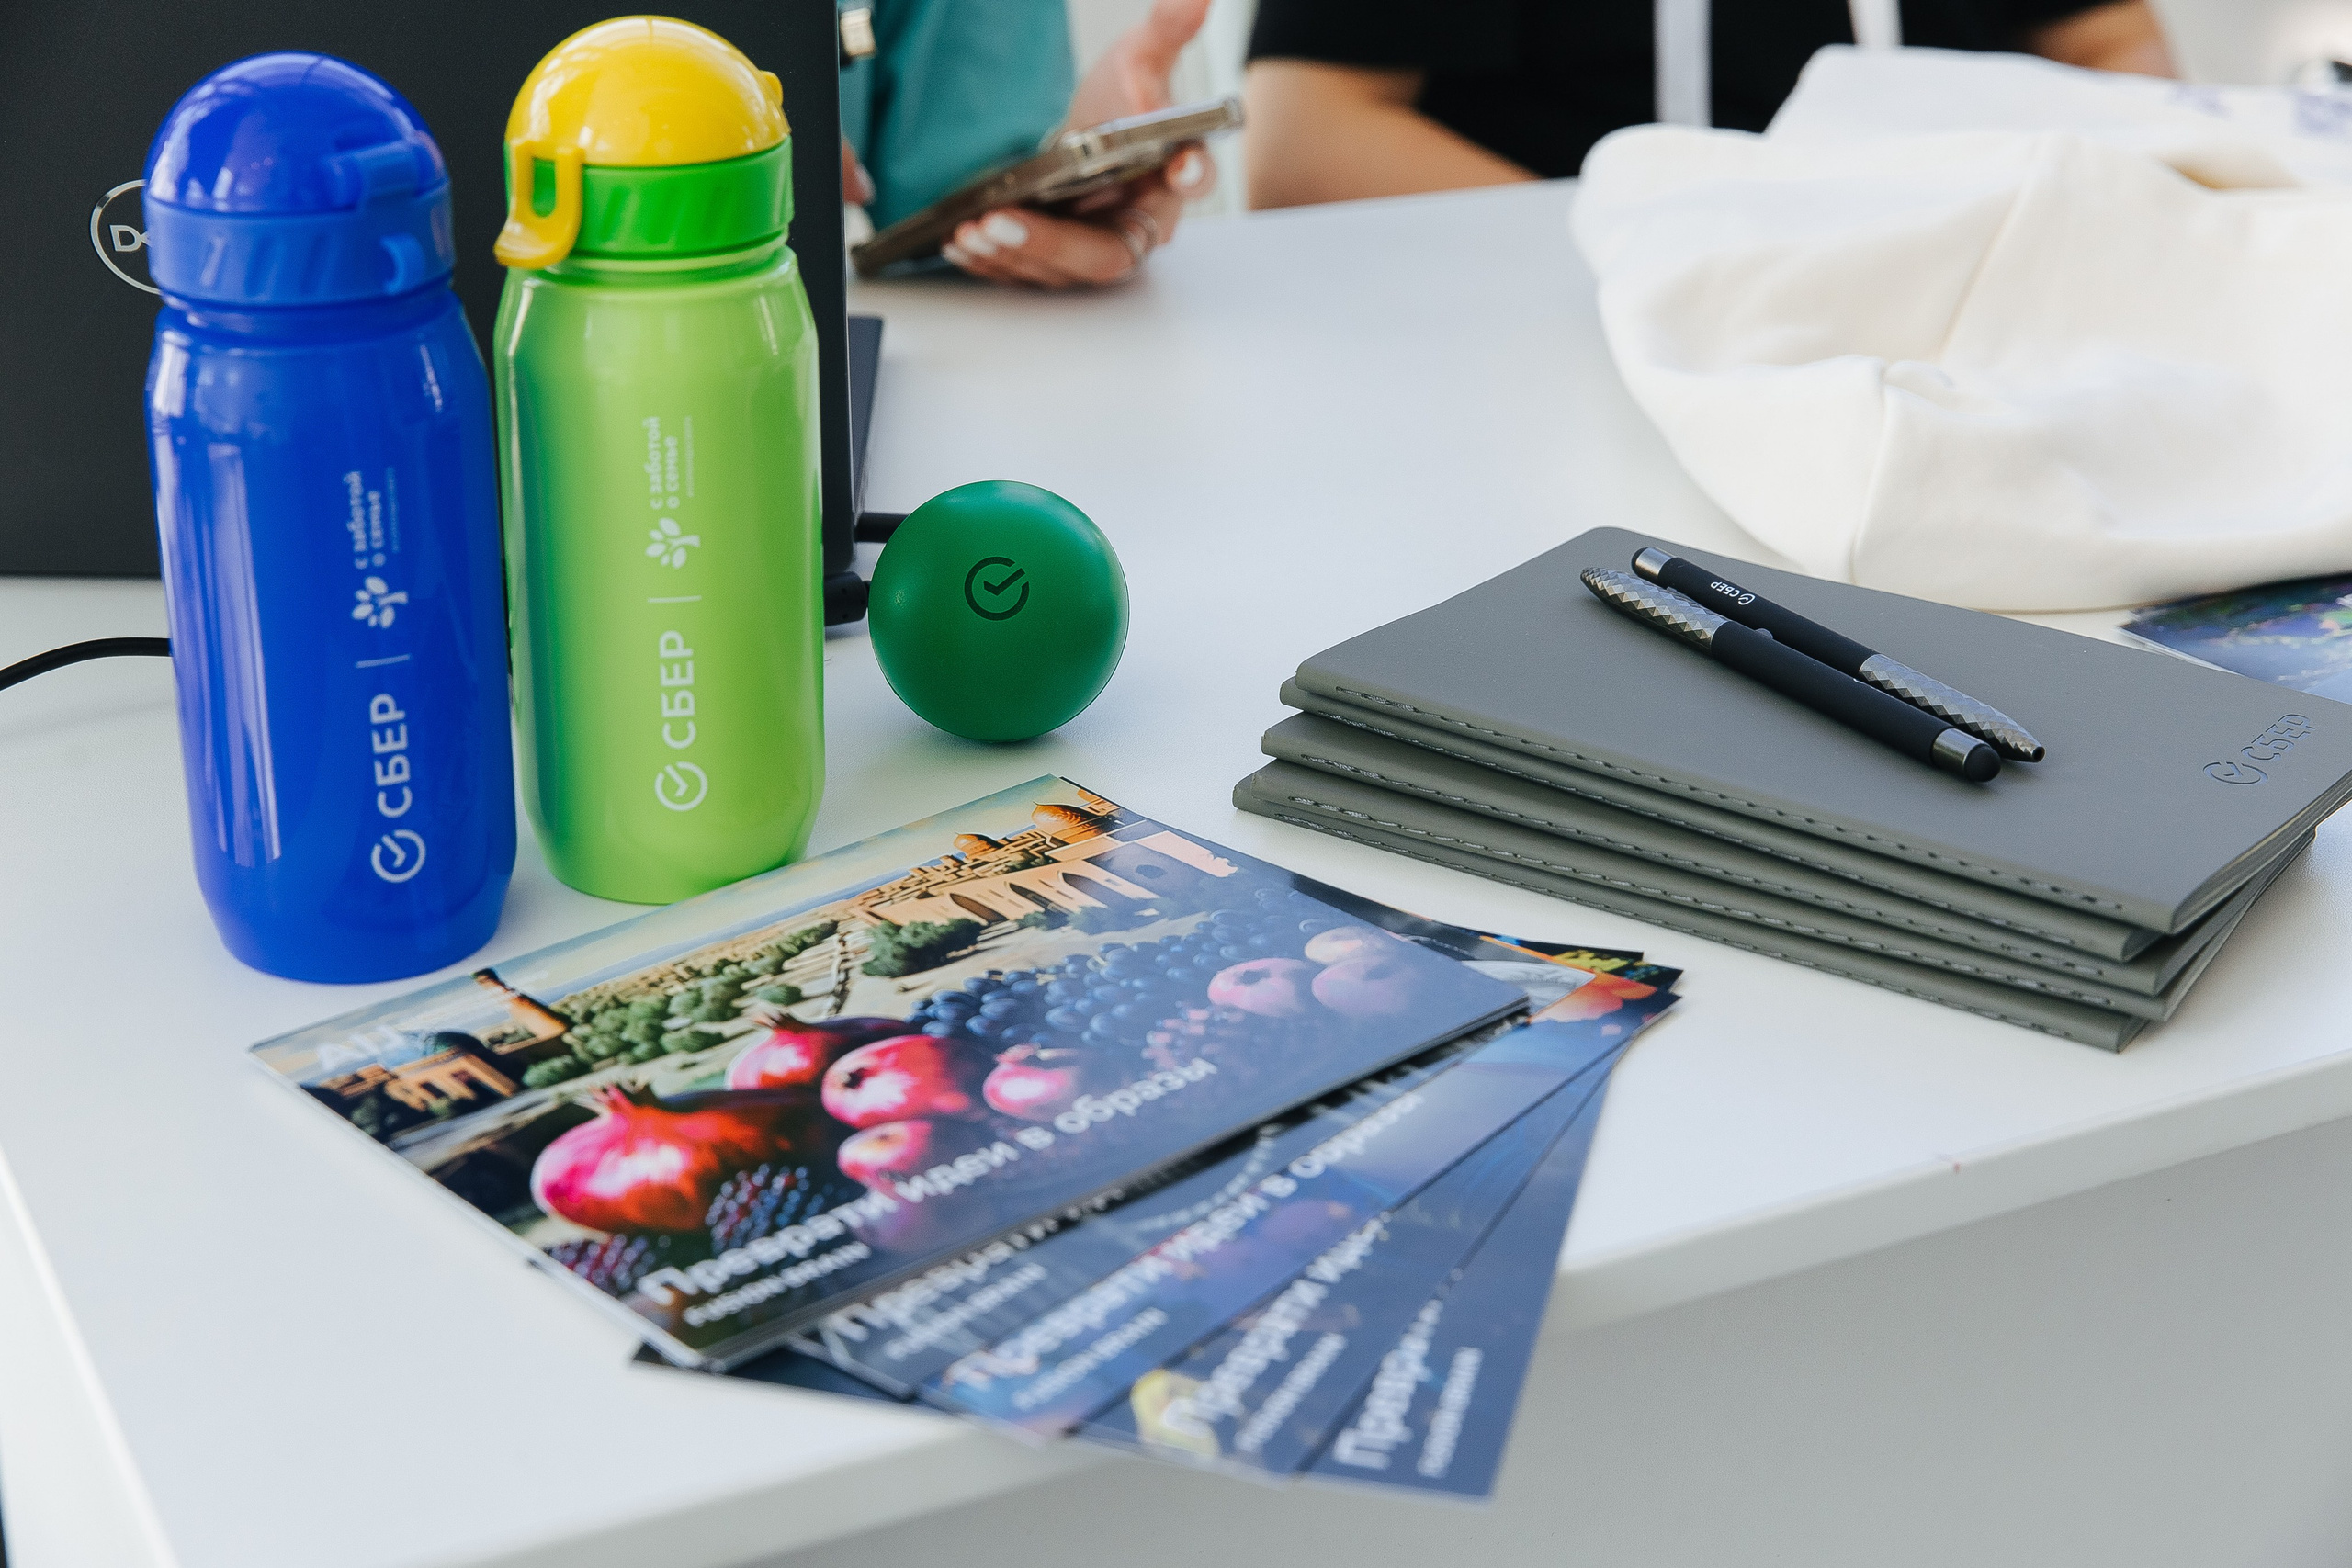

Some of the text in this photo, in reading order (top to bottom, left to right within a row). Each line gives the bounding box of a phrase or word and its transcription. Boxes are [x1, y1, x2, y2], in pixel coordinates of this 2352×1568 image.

[1710, 581, 1741, 597] СБЕР
[658, 629, 696, 750] СБЕР
[2240, 713, 2316, 762] СБЕР
[369, 693, 413, 818] СБЕР
[638, 1056, 1217, 1306] Преврати идеи в образы
